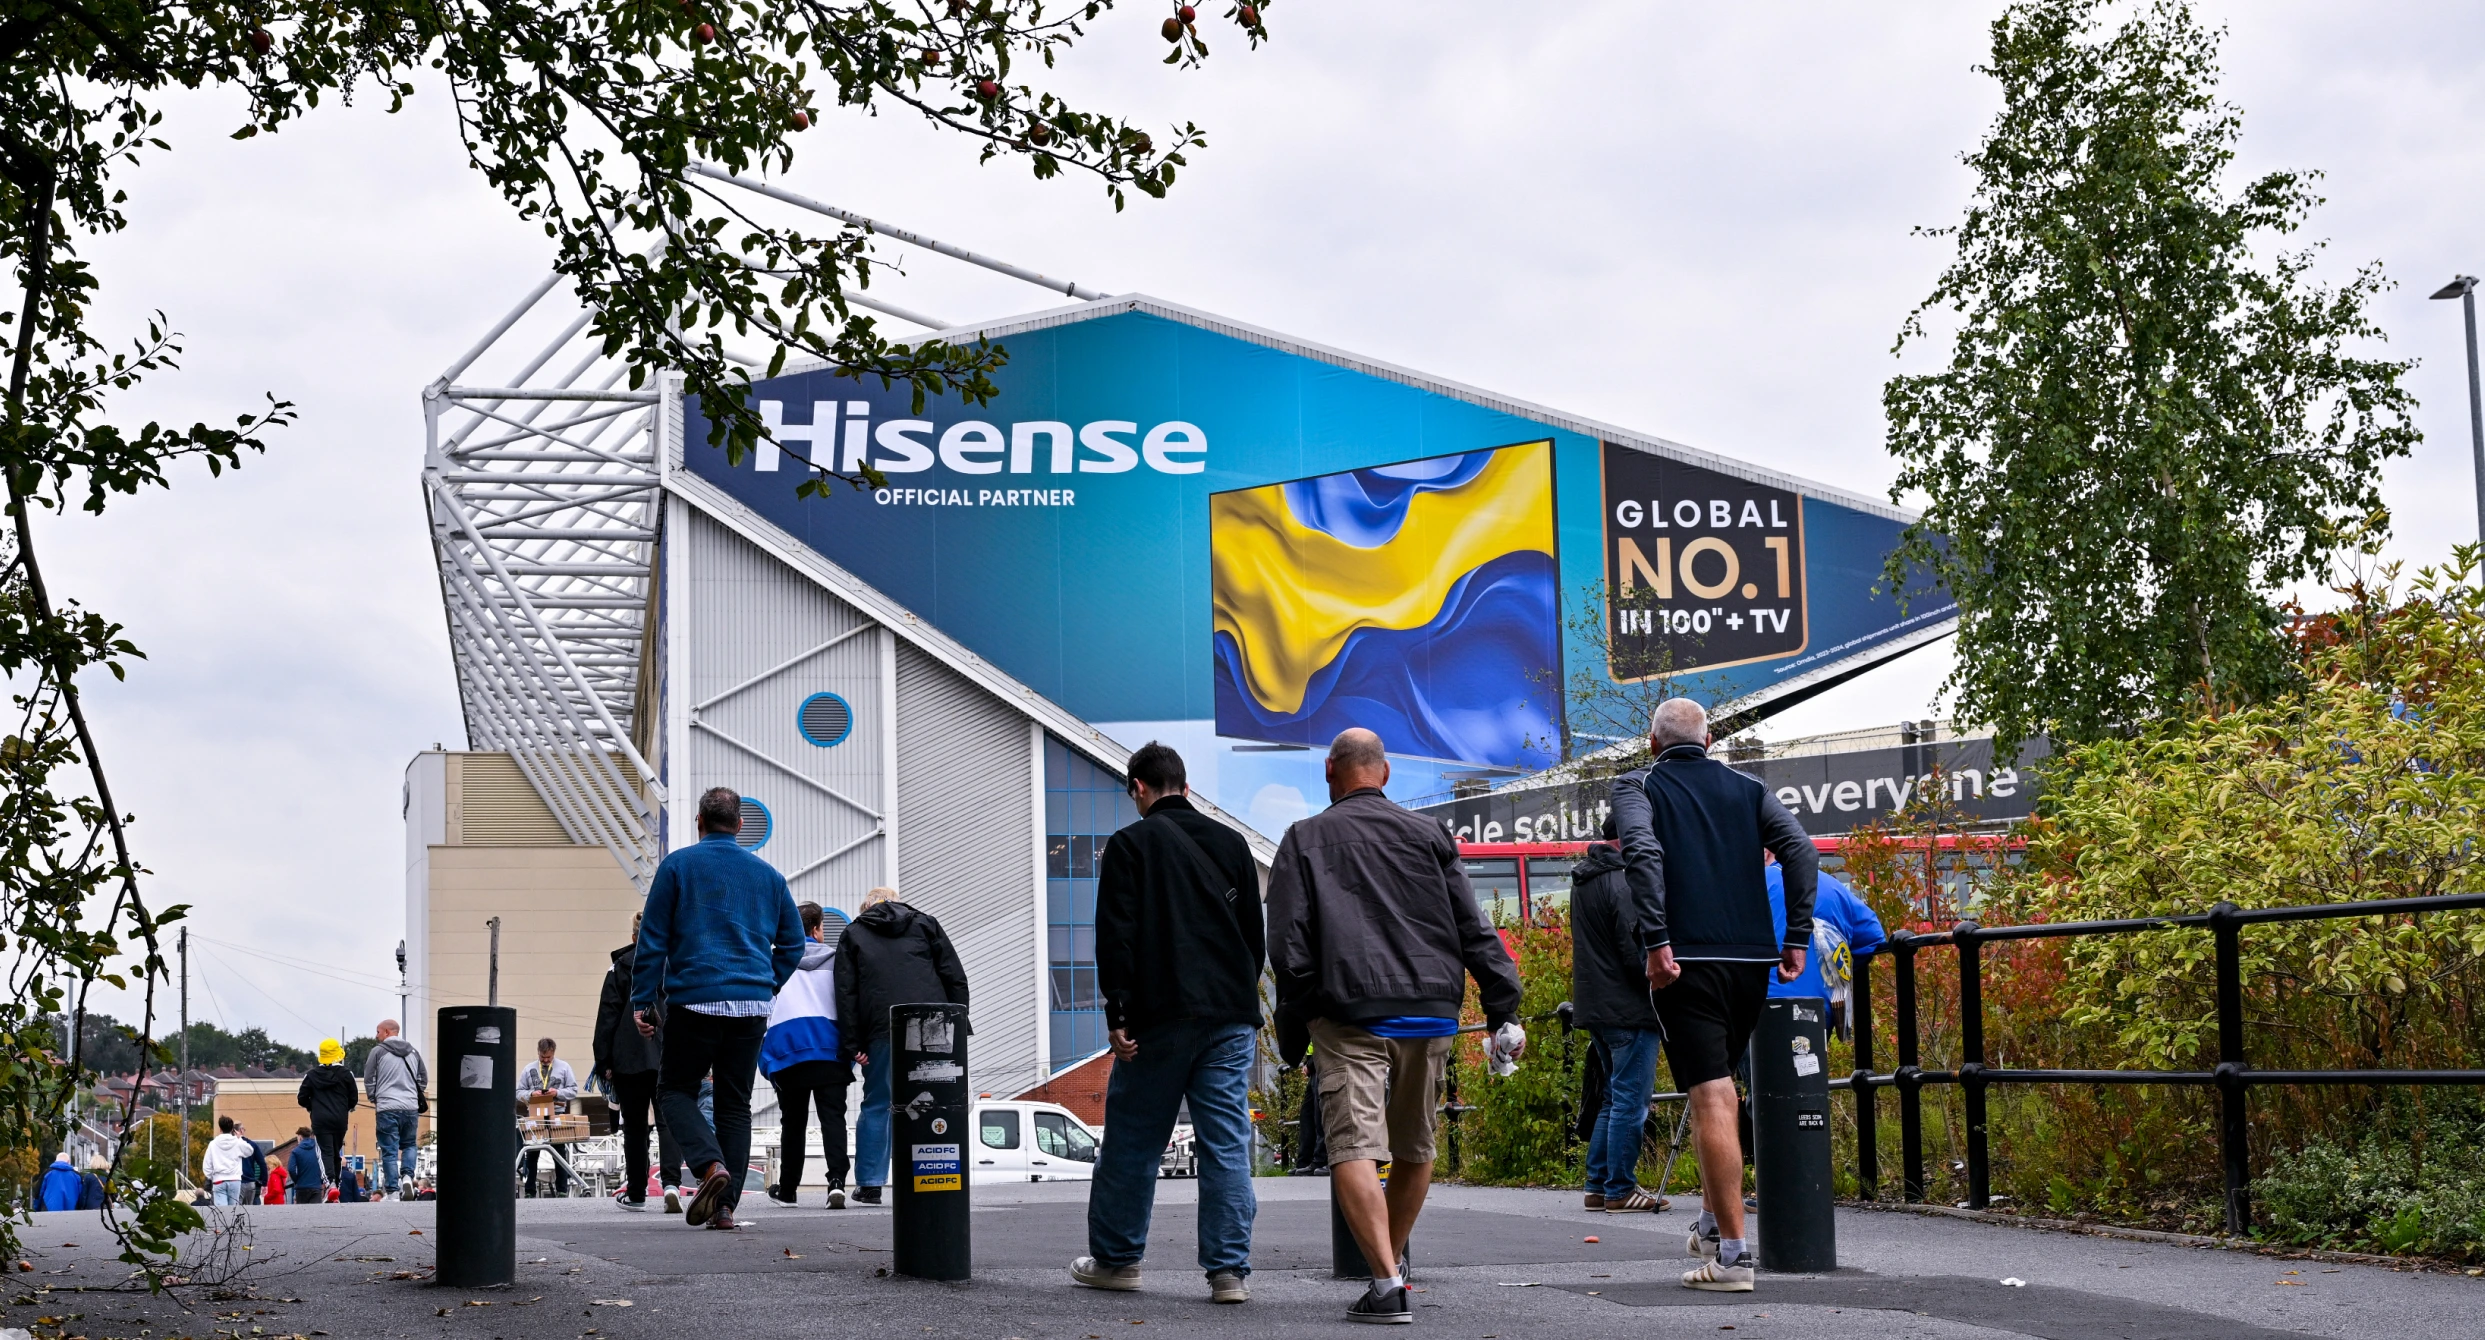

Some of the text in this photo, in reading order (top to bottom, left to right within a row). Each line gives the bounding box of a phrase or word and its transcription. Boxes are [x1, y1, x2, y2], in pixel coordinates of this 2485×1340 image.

[755, 400, 1208, 474] Hisense
[874, 488, 1075, 506] OFFICIAL PARTNER
[1616, 500, 1788, 528] GLOBAL
[1618, 537, 1790, 599] NO.1
[1620, 610, 1652, 634] IN
[1750, 609, 1791, 633] TV
[1844, 637, 1861, 649] global
[1862, 628, 1889, 641] shipments
[1889, 624, 1900, 632] unit
[1900, 617, 1915, 627] share
[1941, 604, 1952, 613] and
[1776, 766, 2018, 818] everyone
[918, 1162, 957, 1170] ACID FC
